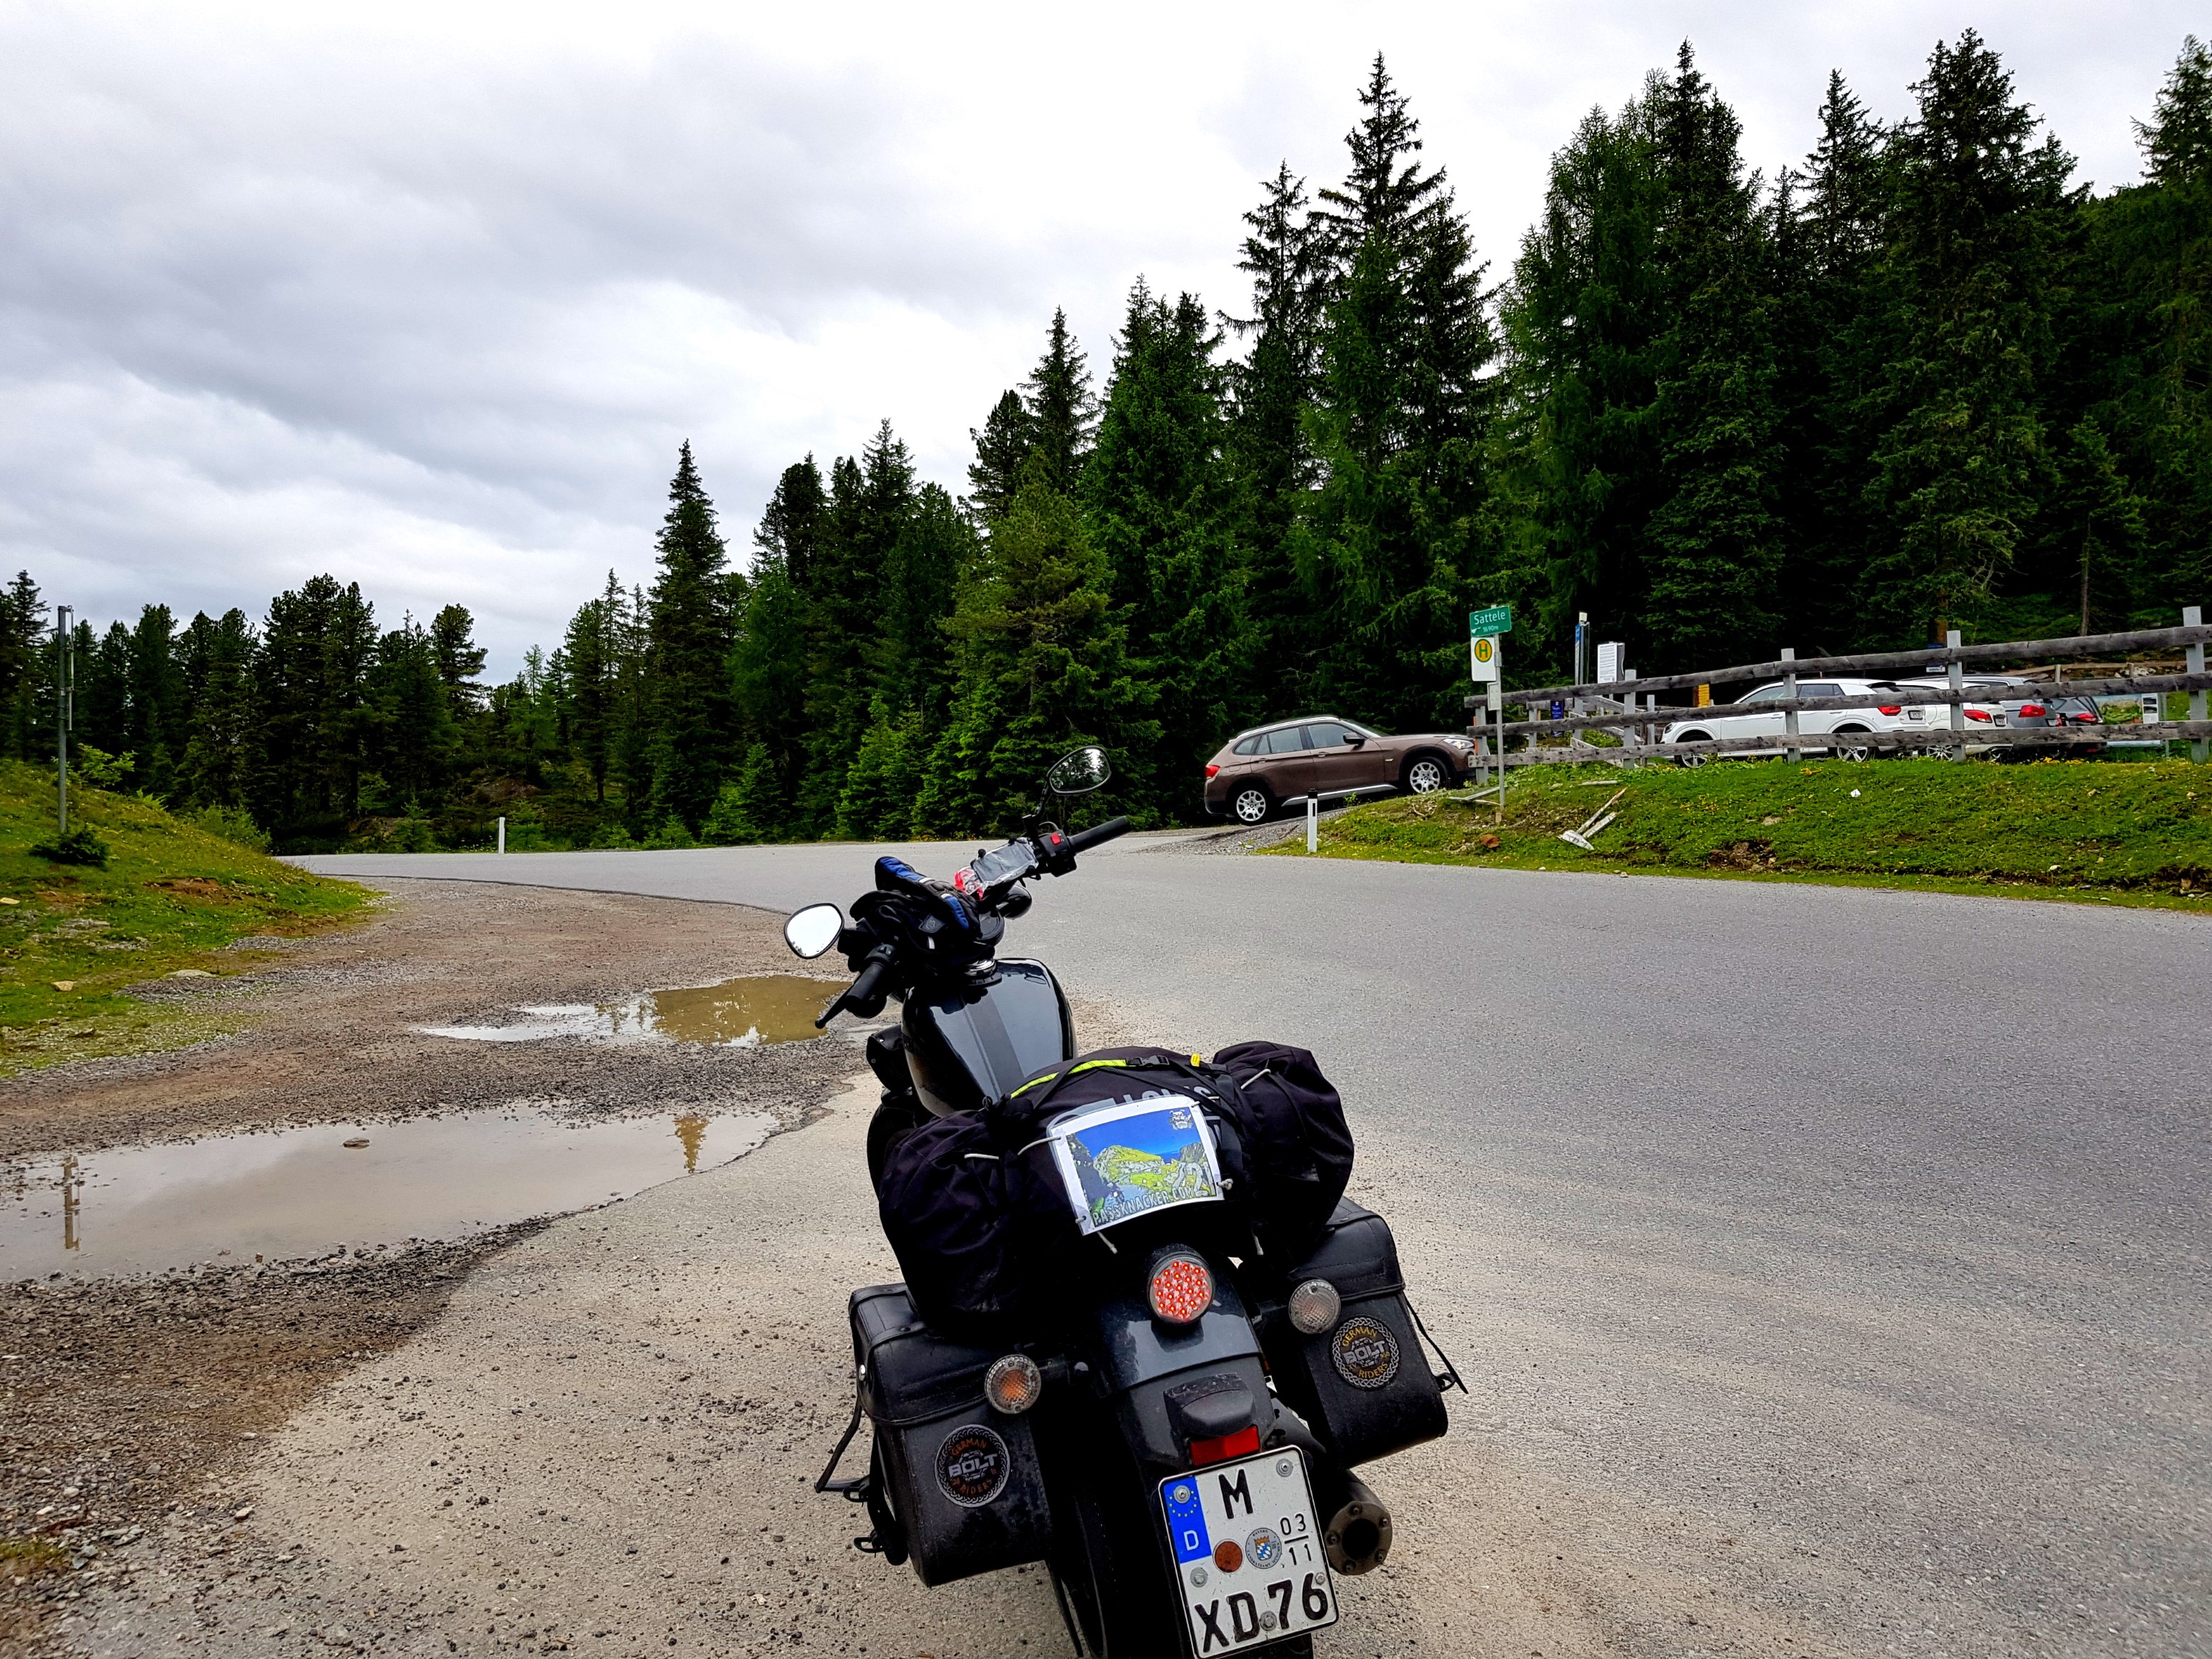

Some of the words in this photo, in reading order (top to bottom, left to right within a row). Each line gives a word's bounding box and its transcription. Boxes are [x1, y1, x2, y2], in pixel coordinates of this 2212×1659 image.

[1474, 610, 1506, 625] Sattele
[1478, 643, 1488, 658] H
[1342, 1326, 1378, 1347] GERMAN
[1343, 1340, 1385, 1365] BOLT
[1358, 1361, 1389, 1379] RIDERS
[952, 1438, 987, 1455] GERMAN
[948, 1453, 998, 1478] BOLT
[1218, 1468, 1253, 1519] M
[1280, 1513, 1307, 1535] 03
[1183, 1530, 1200, 1551] D
[1288, 1543, 1312, 1565] 11
